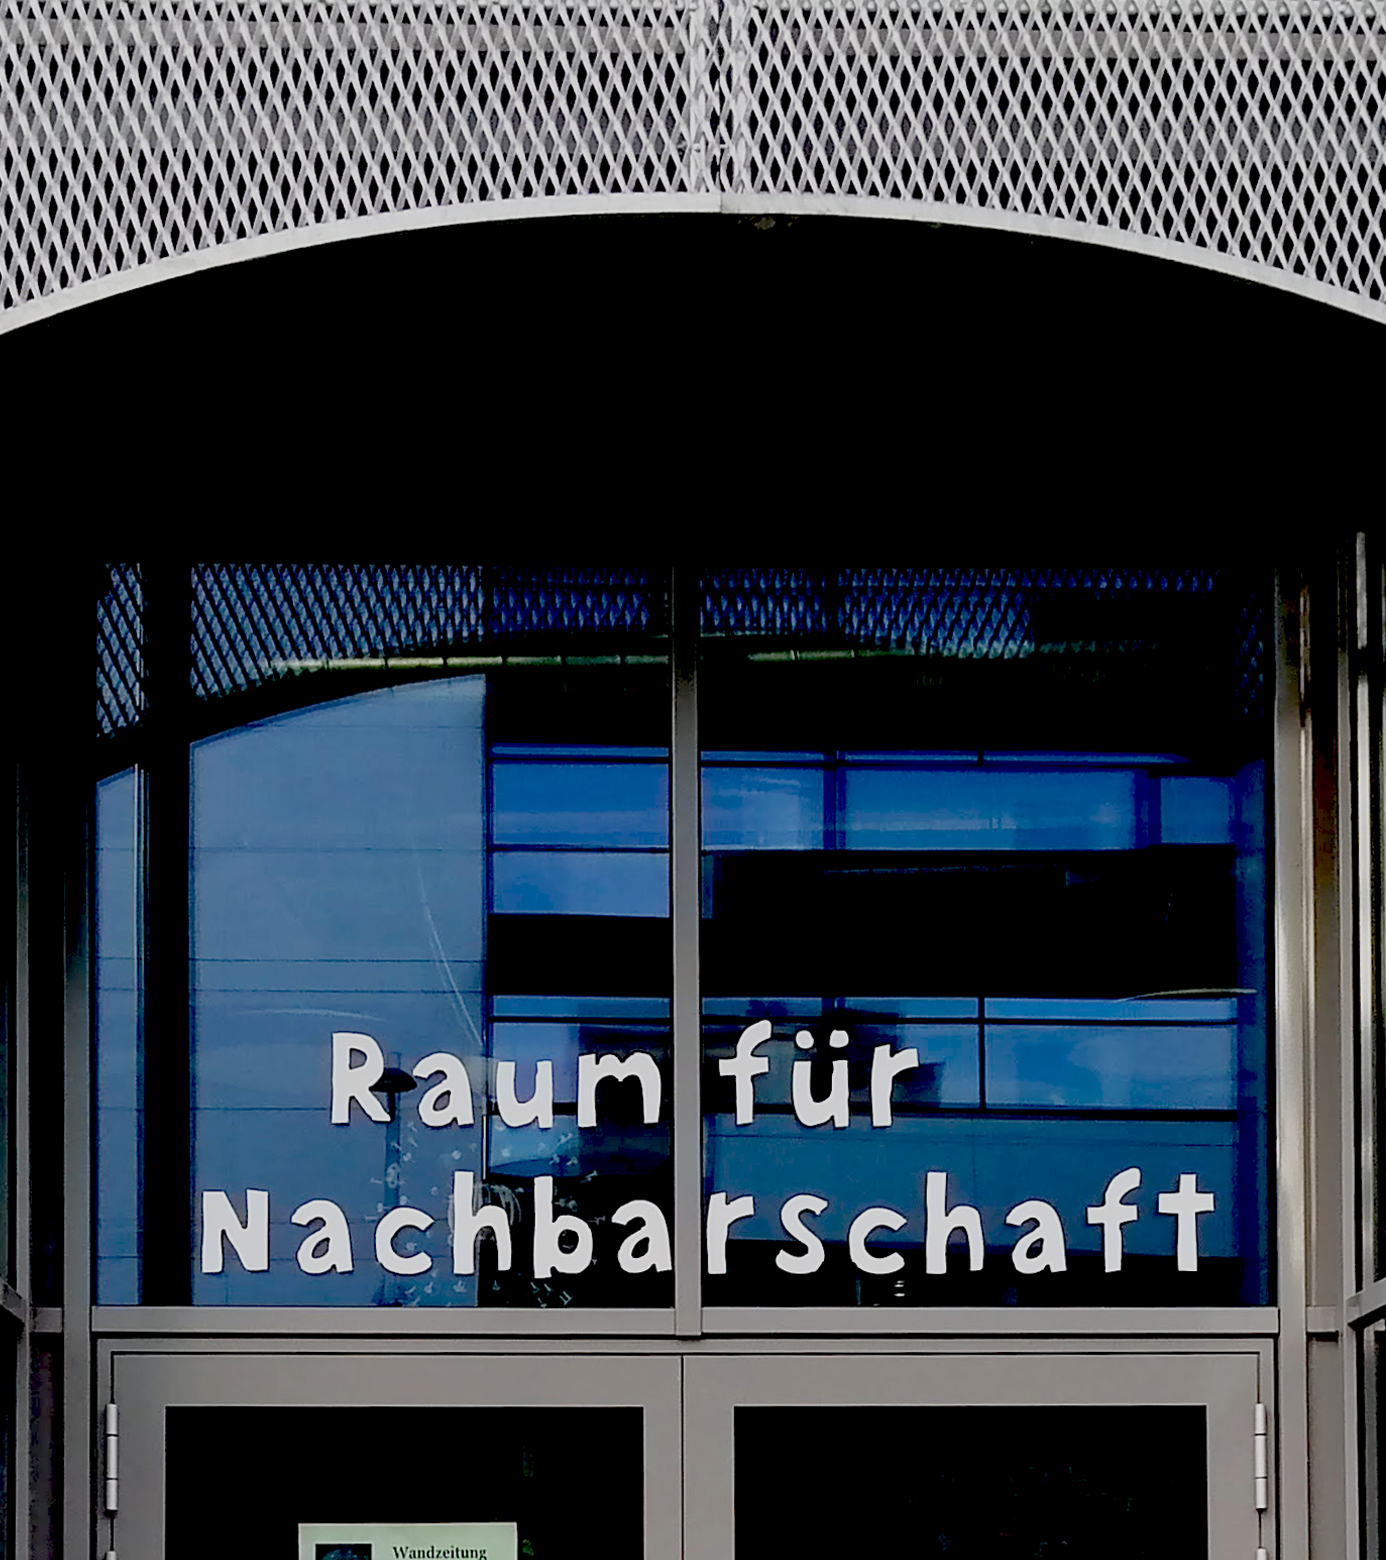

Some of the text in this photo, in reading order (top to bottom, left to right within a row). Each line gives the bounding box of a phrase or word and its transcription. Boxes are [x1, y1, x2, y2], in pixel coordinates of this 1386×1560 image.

[329, 1019, 920, 1129] Raum für
[201, 1167, 1215, 1280] Nachbarschaft
